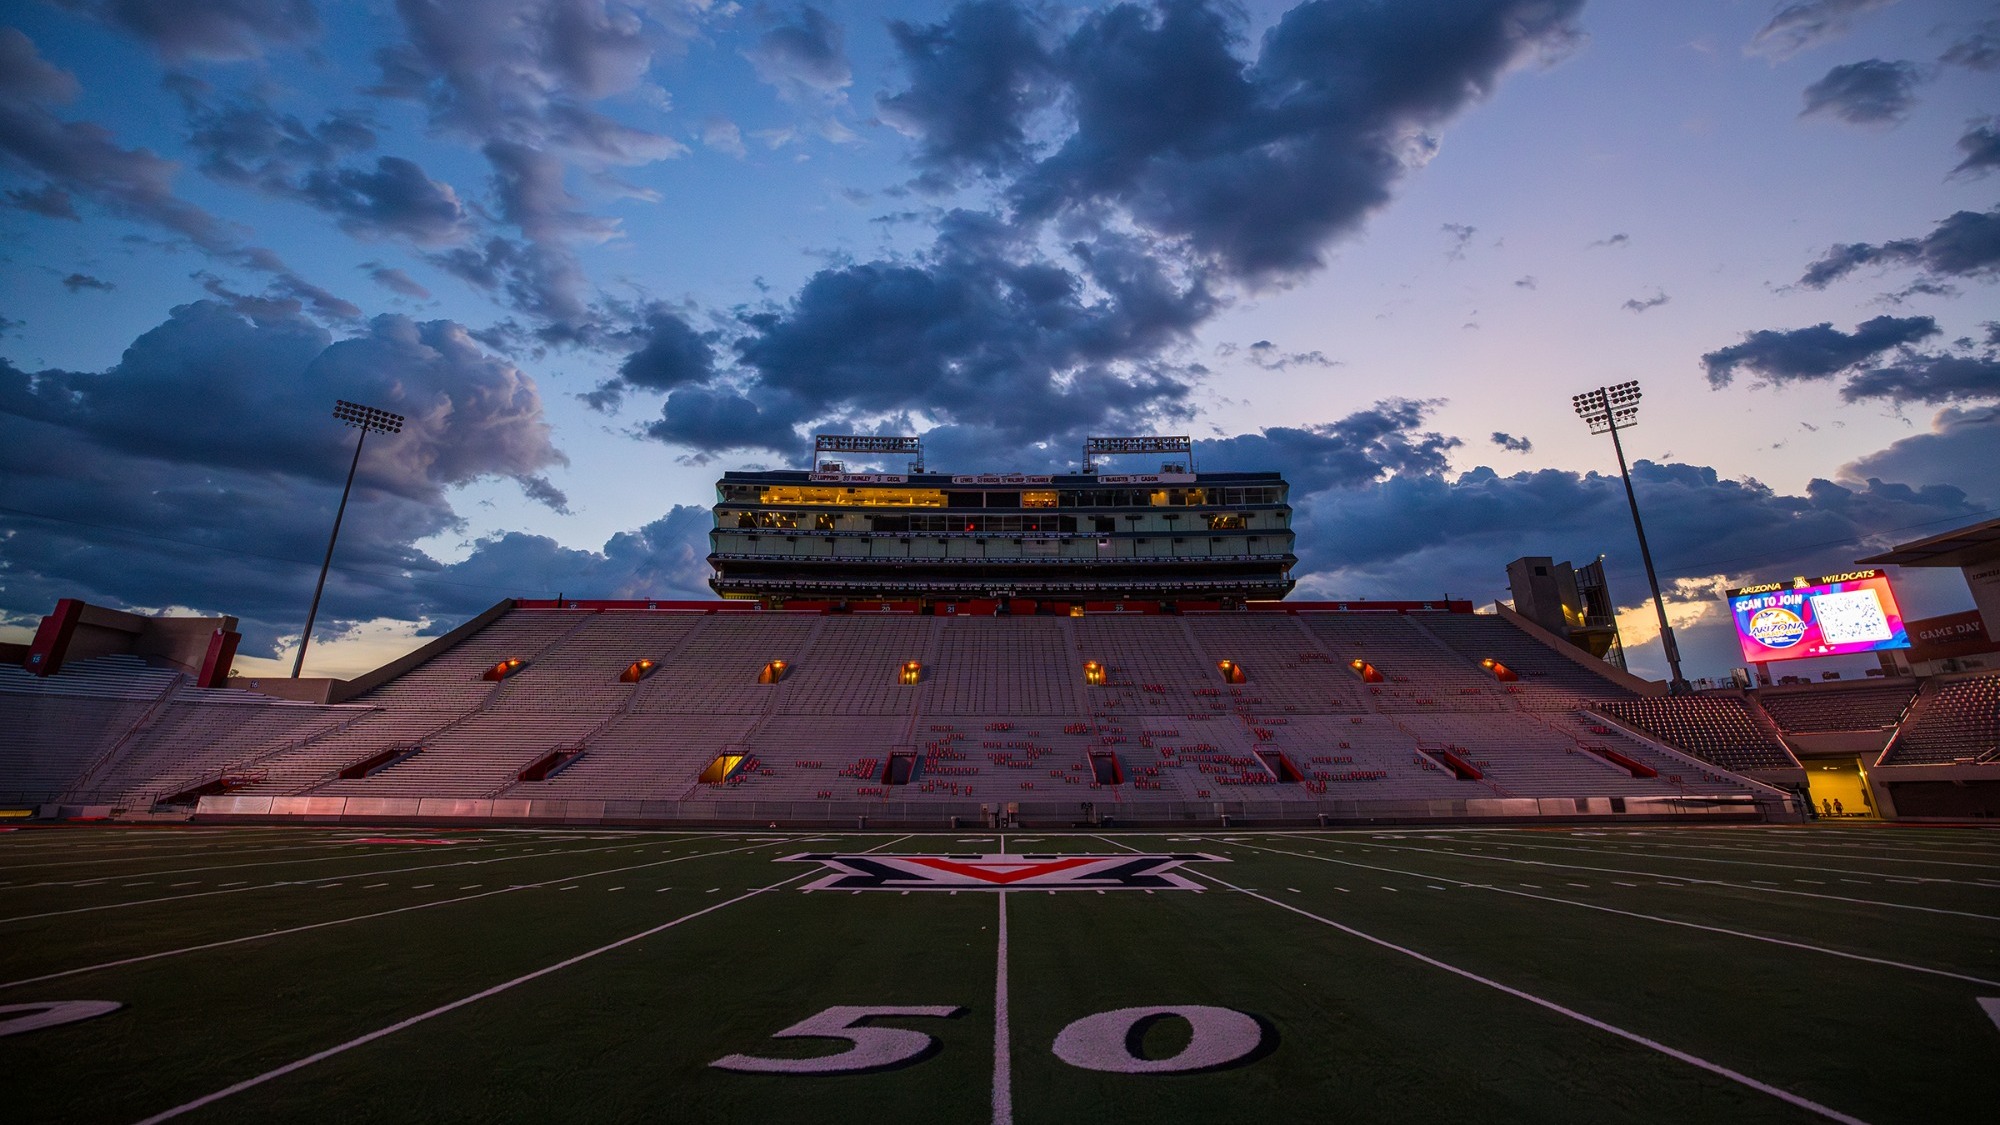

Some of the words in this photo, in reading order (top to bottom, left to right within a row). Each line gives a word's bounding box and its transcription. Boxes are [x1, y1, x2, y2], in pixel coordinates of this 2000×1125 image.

[1739, 583, 1781, 595] ARIZONA
[1822, 570, 1875, 583] WILDCATS
[1735, 598, 1762, 612] SCAN
[1763, 597, 1776, 607] TO
[1777, 594, 1803, 607] JOIN
[1751, 621, 1806, 637] ARIZONA
[1919, 626, 1953, 640] GAME
[1956, 622, 1980, 633] DAY
[708, 1005, 966, 1076] 5
[1052, 1004, 1278, 1076] 0
